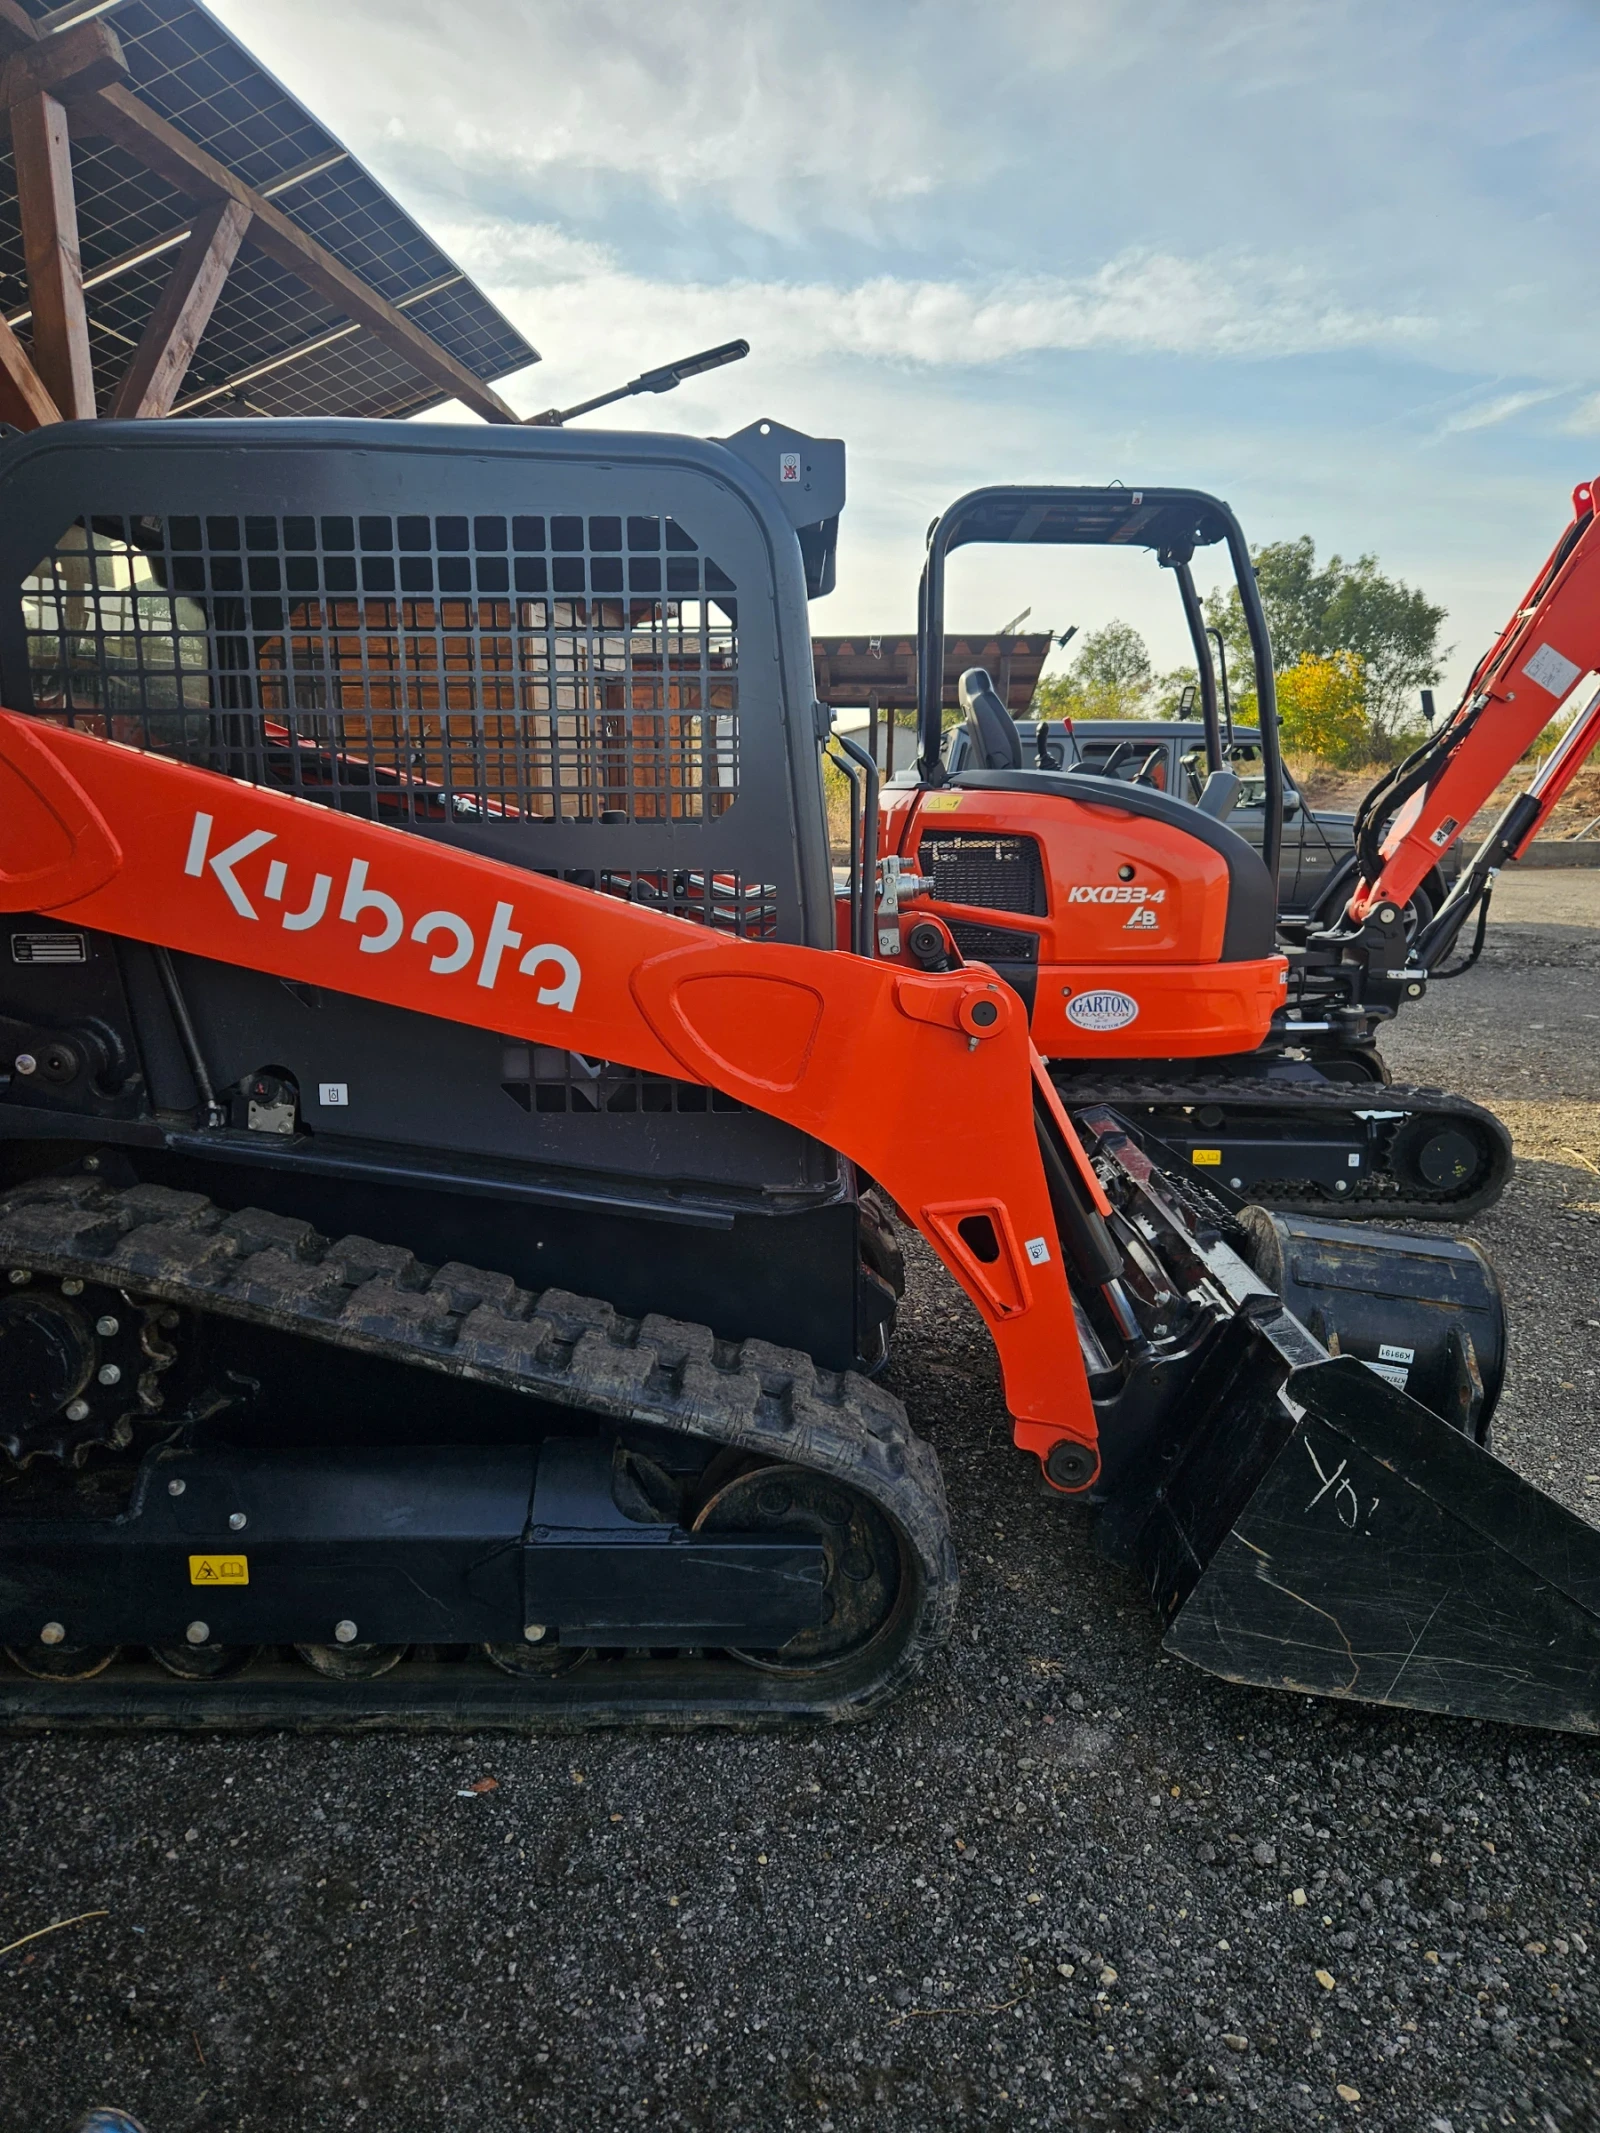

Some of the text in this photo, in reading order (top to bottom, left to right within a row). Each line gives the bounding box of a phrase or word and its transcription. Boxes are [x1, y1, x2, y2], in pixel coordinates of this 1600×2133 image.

[1067, 886, 1166, 904] KX033-4
[184, 810, 582, 1013] Kubota
[1072, 996, 1130, 1013] GARTON
[1381, 1348, 1411, 1360] K99191
